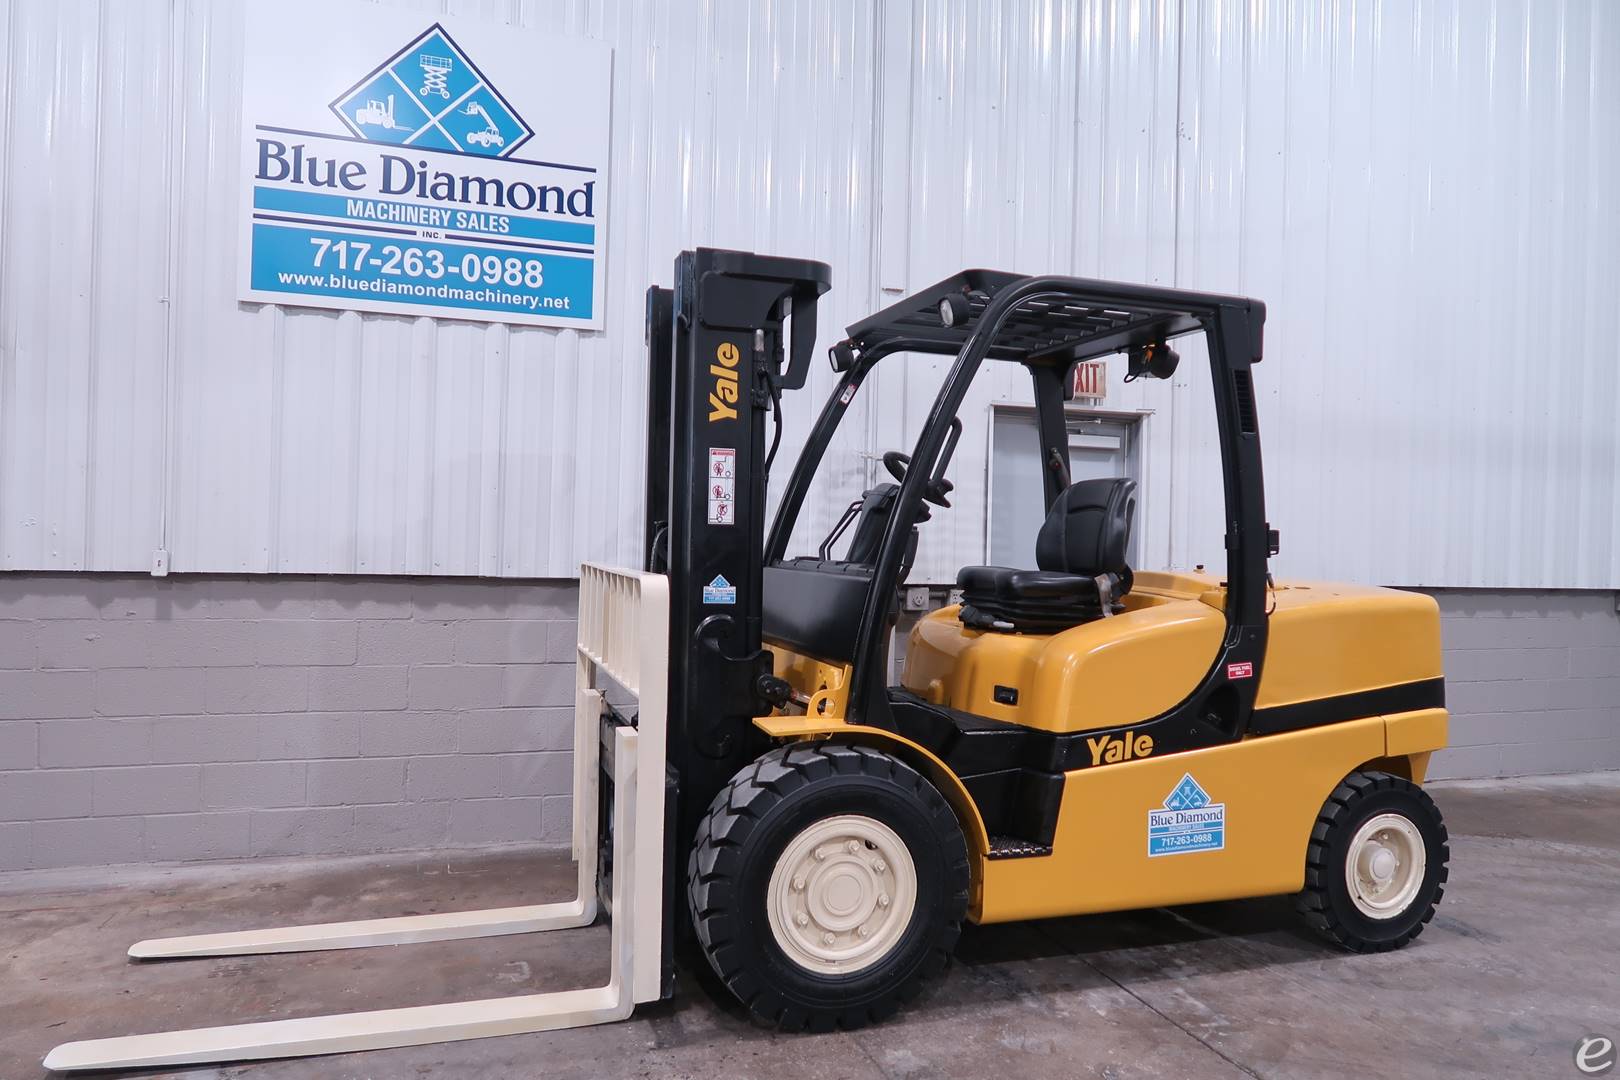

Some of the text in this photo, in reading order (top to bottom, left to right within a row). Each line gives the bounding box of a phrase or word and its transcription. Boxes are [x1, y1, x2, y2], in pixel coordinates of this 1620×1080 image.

[255, 138, 596, 218] Blue Diamond
[346, 199, 510, 233] MACHINERY SALES
[422, 231, 442, 239] INC.
[310, 237, 544, 289] 717-263-0988
[278, 272, 570, 310] www.bluediamondmachinery.net
[708, 342, 741, 422] Yale
[1075, 363, 1100, 393] XIT
[1087, 731, 1154, 765] Yale
[1151, 809, 1223, 826] Blue Diamond
[1161, 833, 1212, 847] 717-263-0988
